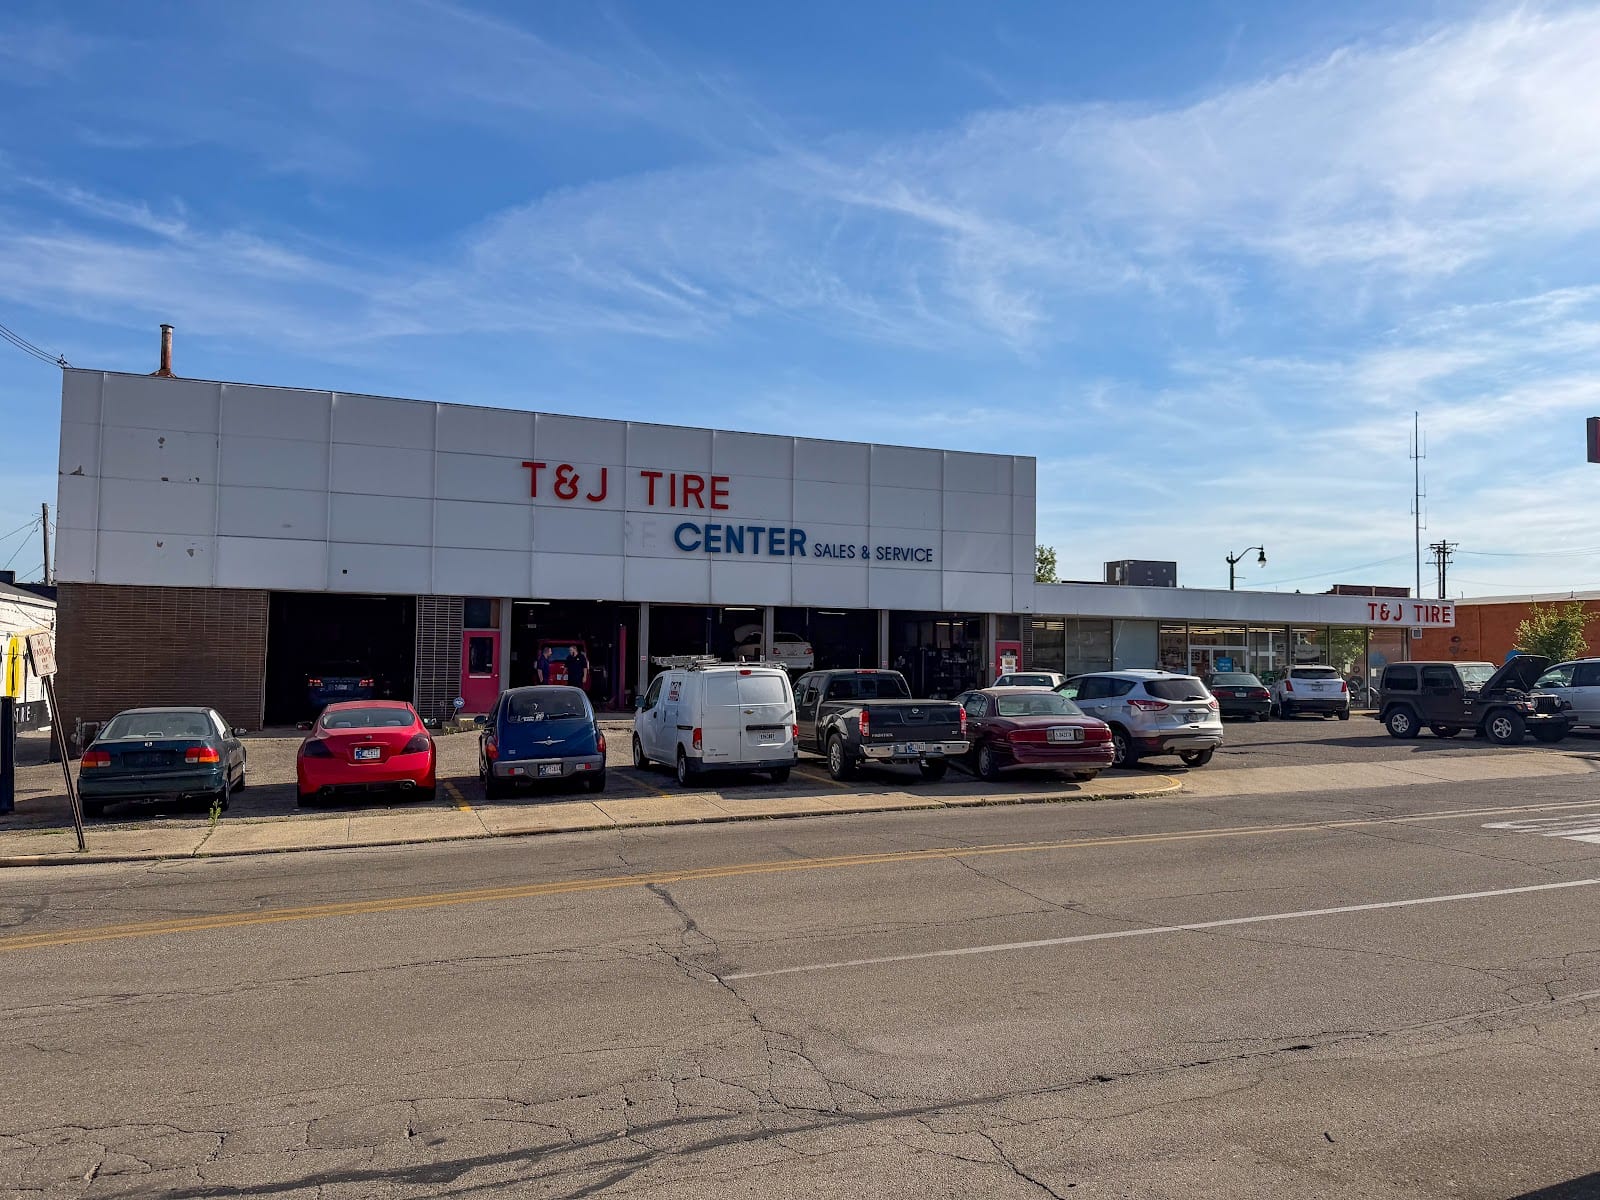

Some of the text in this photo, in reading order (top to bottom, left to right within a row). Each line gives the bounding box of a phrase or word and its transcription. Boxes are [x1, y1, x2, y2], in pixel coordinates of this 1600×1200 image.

[522, 462, 729, 509] T&J TIRE
[674, 522, 933, 562] CENTER SALES & SERVICE
[1367, 602, 1451, 623] T&J TIRE
